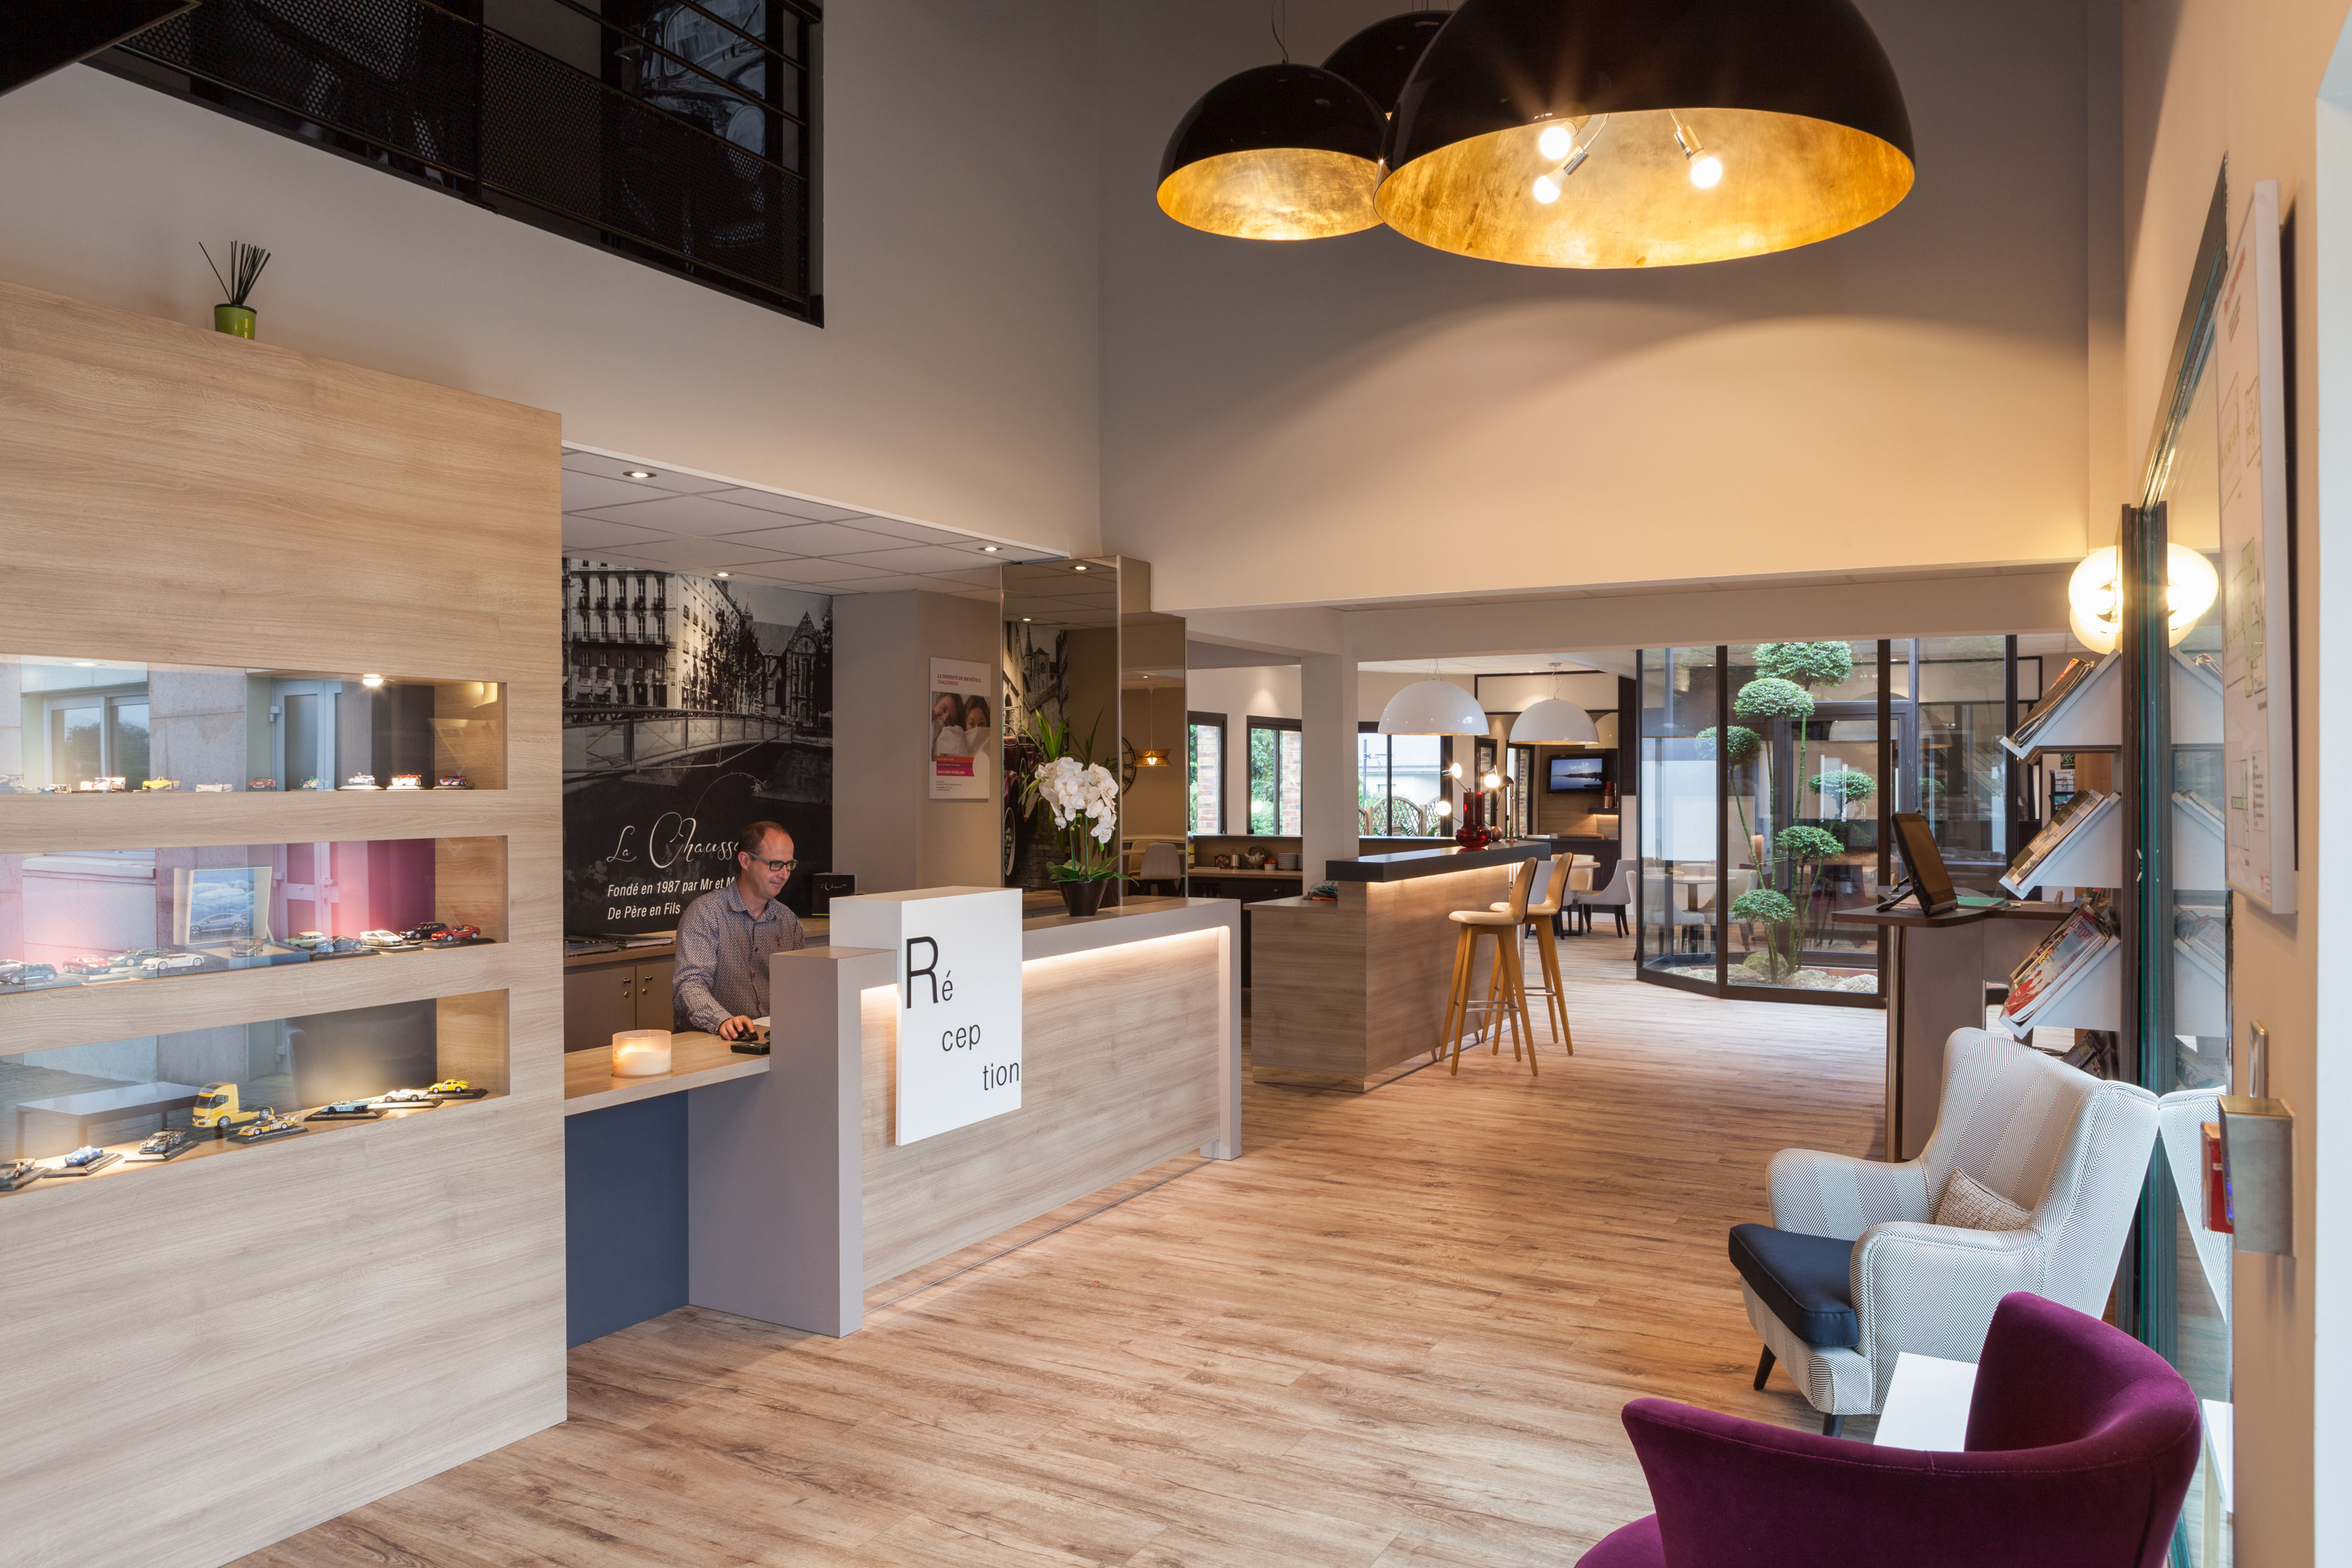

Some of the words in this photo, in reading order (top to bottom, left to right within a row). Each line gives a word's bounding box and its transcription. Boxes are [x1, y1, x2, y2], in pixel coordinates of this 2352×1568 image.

[606, 826, 637, 862] La
[607, 882, 638, 897] Fondé
[641, 884, 653, 894] en
[657, 880, 681, 894] 1987
[682, 882, 698, 894] par
[700, 878, 714, 890] Mr
[714, 877, 724, 889] et
[607, 907, 621, 920] De
[624, 905, 646, 918] Père
[650, 905, 661, 916] en
[664, 903, 681, 915] Fils
[906, 936, 954, 1009] Ré
[941, 1024, 981, 1051] cep
[982, 1062, 1020, 1091] tion
